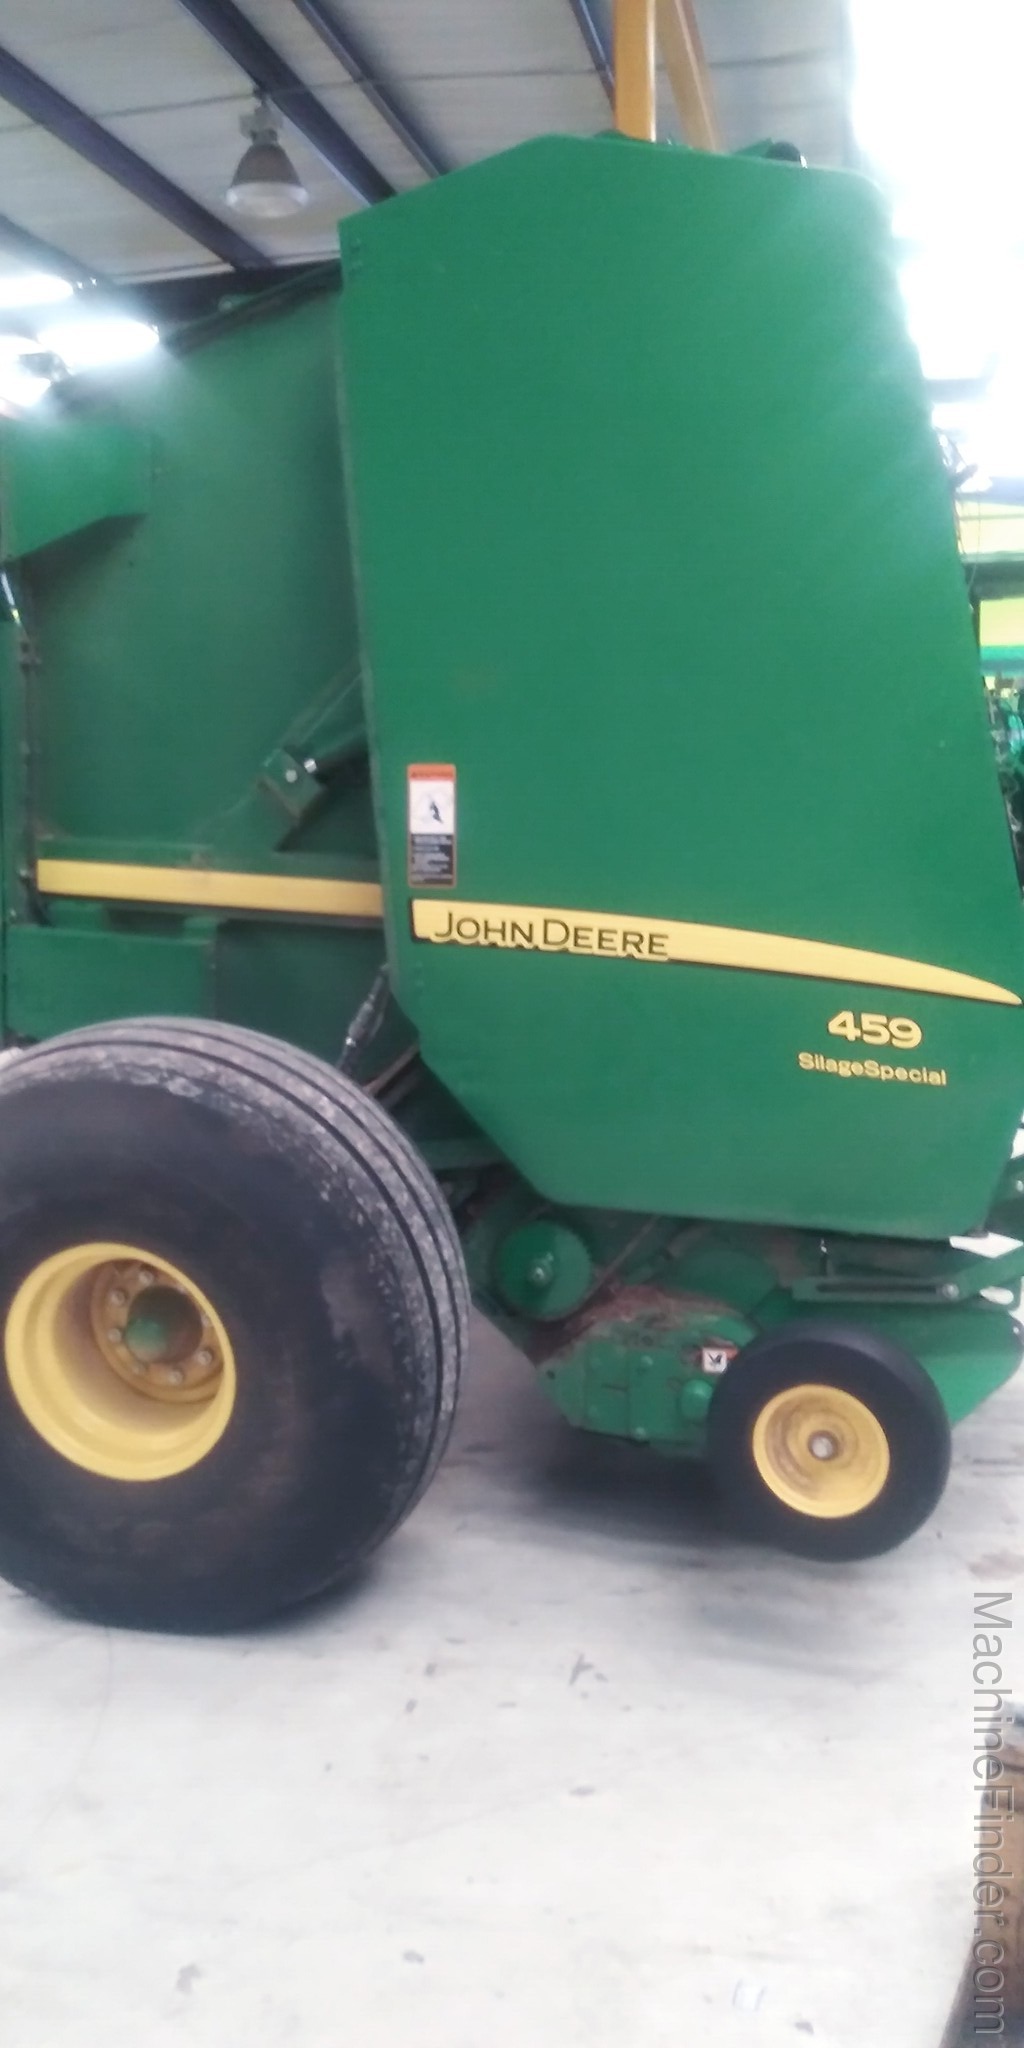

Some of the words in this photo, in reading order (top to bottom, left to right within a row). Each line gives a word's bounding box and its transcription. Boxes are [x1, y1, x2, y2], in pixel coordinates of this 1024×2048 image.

[434, 911, 534, 945] JOHN
[542, 918, 669, 957] DEERE
[827, 1010, 923, 1049] 459
[798, 1052, 947, 1086] SilageSpecial
